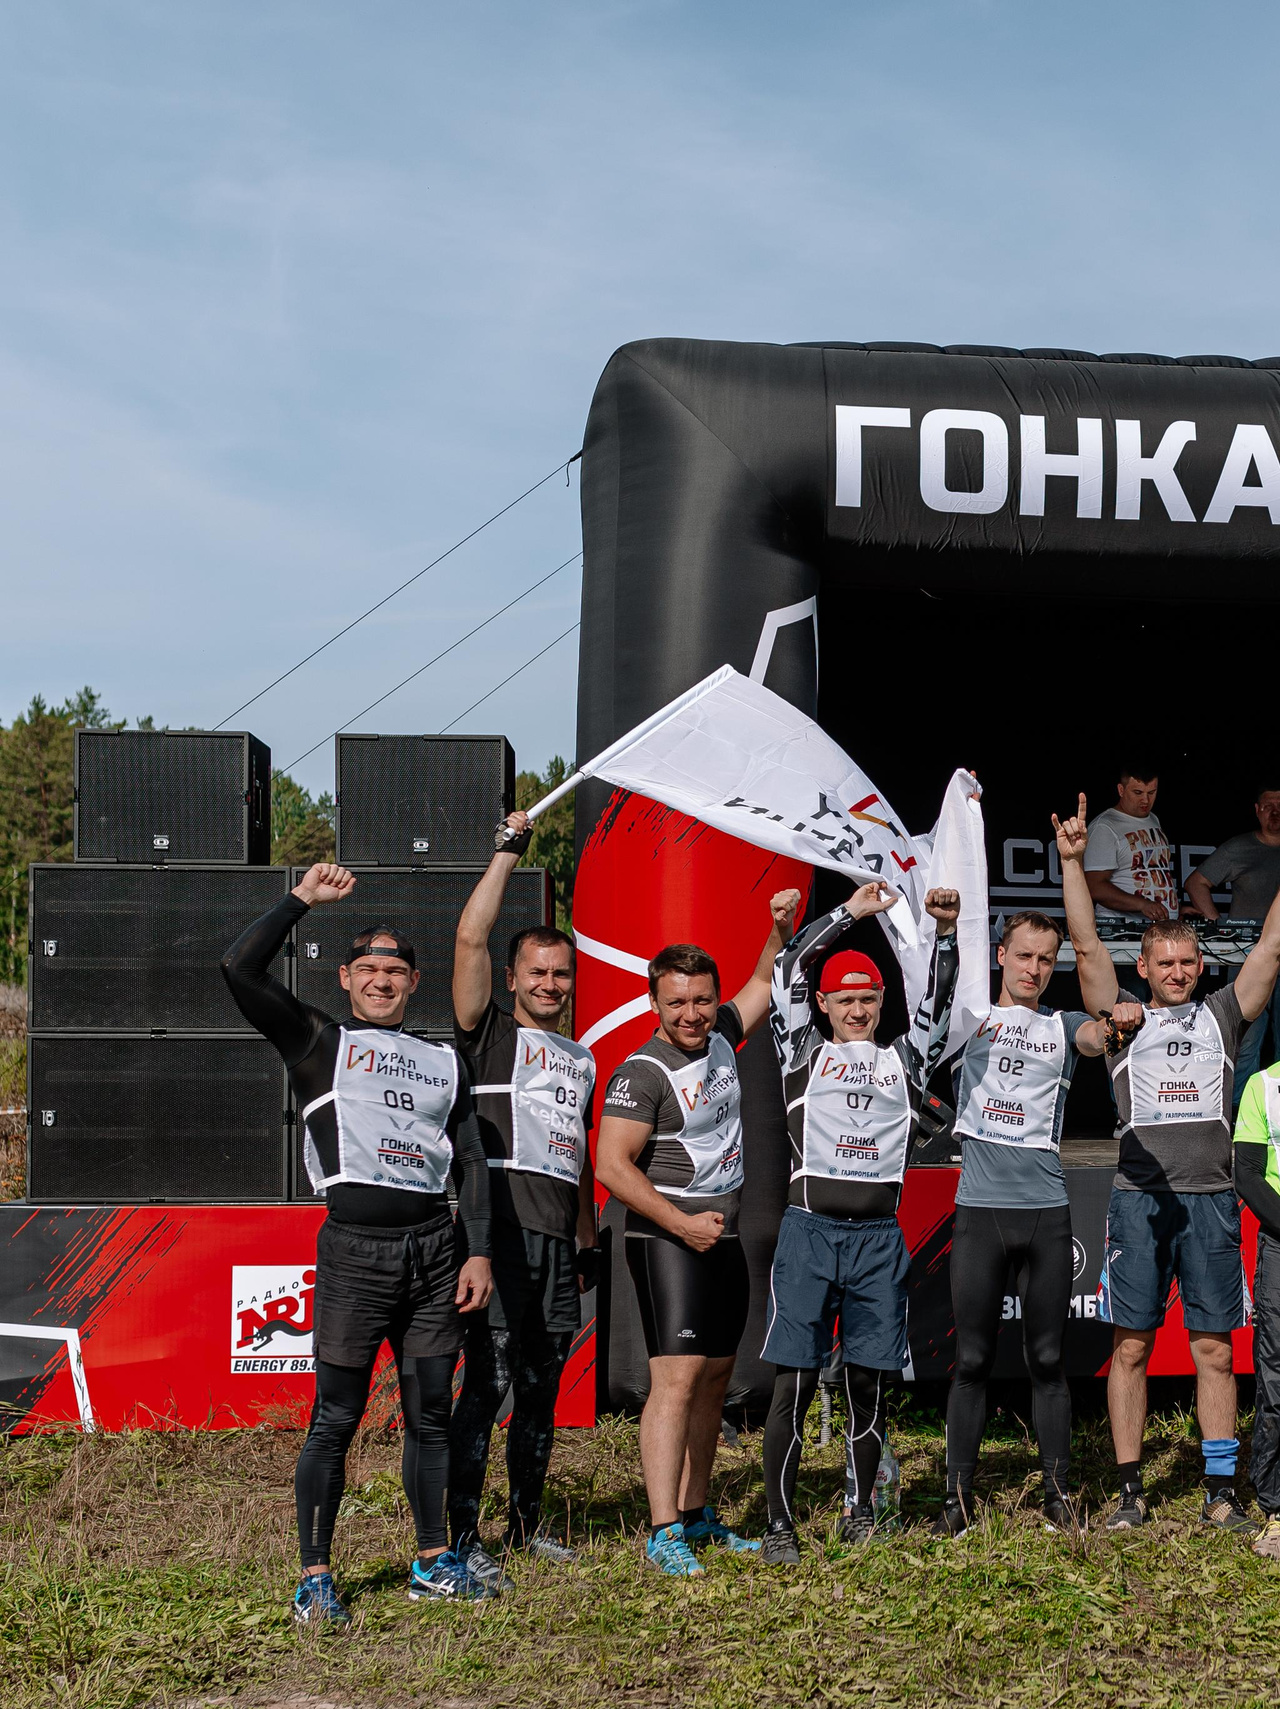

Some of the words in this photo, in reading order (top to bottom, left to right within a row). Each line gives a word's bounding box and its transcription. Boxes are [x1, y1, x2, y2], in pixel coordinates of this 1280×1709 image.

[1005, 1025, 1028, 1039] УРАЛ
[997, 1035, 1057, 1053] ИНТЕРЬЕР
[1166, 1041, 1192, 1057] 03
[378, 1052, 417, 1070] УРАЛ
[849, 1061, 874, 1073] УРАЛ
[998, 1056, 1024, 1077] 02
[376, 1063, 449, 1088] ИНТЕРЬЕР
[843, 1074, 898, 1088] ИНТЕРЬЕР
[705, 1066, 737, 1101] ИНТЕРЬЕ
[1160, 1080, 1196, 1090] ГОНКА
[384, 1089, 415, 1111] 08
[555, 1086, 577, 1107] 03
[611, 1091, 630, 1100] УРАЛ
[846, 1092, 874, 1111] 07
[1158, 1093, 1200, 1103] ГЕРОЕВ
[986, 1097, 1024, 1112] ГОНКА
[715, 1102, 729, 1124] 01
[982, 1110, 1025, 1126] ГЕРОЕВ
[1165, 1111, 1203, 1119] ГАЗПРОМБАНК
[840, 1134, 877, 1147] ГОНКА
[986, 1131, 1025, 1143] ГАЗПРОМБАНК
[381, 1138, 422, 1154] ГОНКА
[378, 1153, 425, 1168] ГЕРОЕВ
[835, 1148, 879, 1161] ГЕРОЕВ
[841, 1169, 880, 1178] ГАЗПРОМБАНК
[236, 1281, 300, 1308] РАДИО
[233, 1359, 288, 1372] ENERGY
